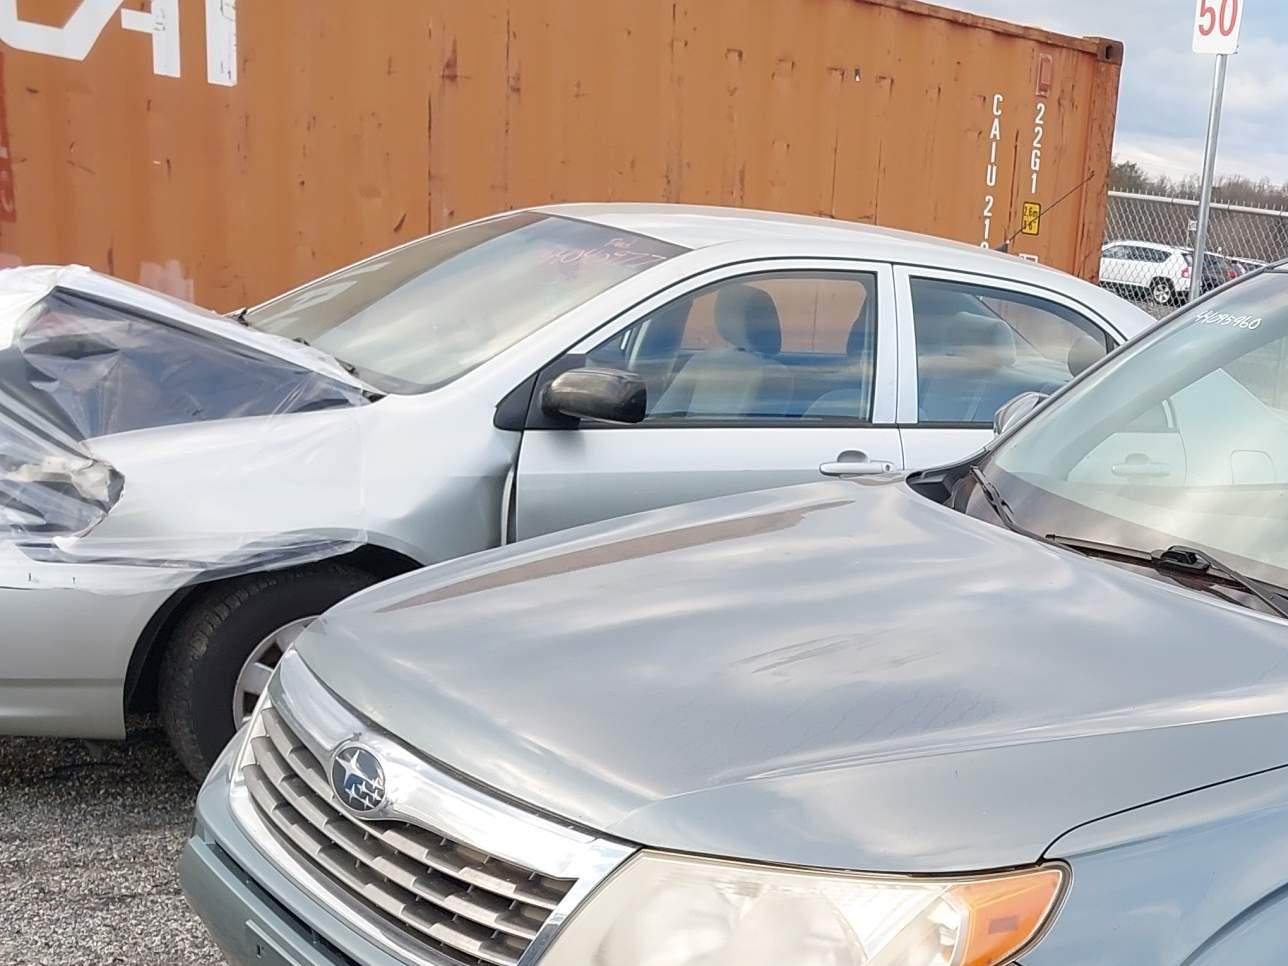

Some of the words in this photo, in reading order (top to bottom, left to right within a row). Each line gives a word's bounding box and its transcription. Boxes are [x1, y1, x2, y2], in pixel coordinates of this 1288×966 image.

[1199, 0, 1238, 37] 50
[986, 94, 1003, 187] CAIU
[1030, 103, 1046, 194] 22G1
